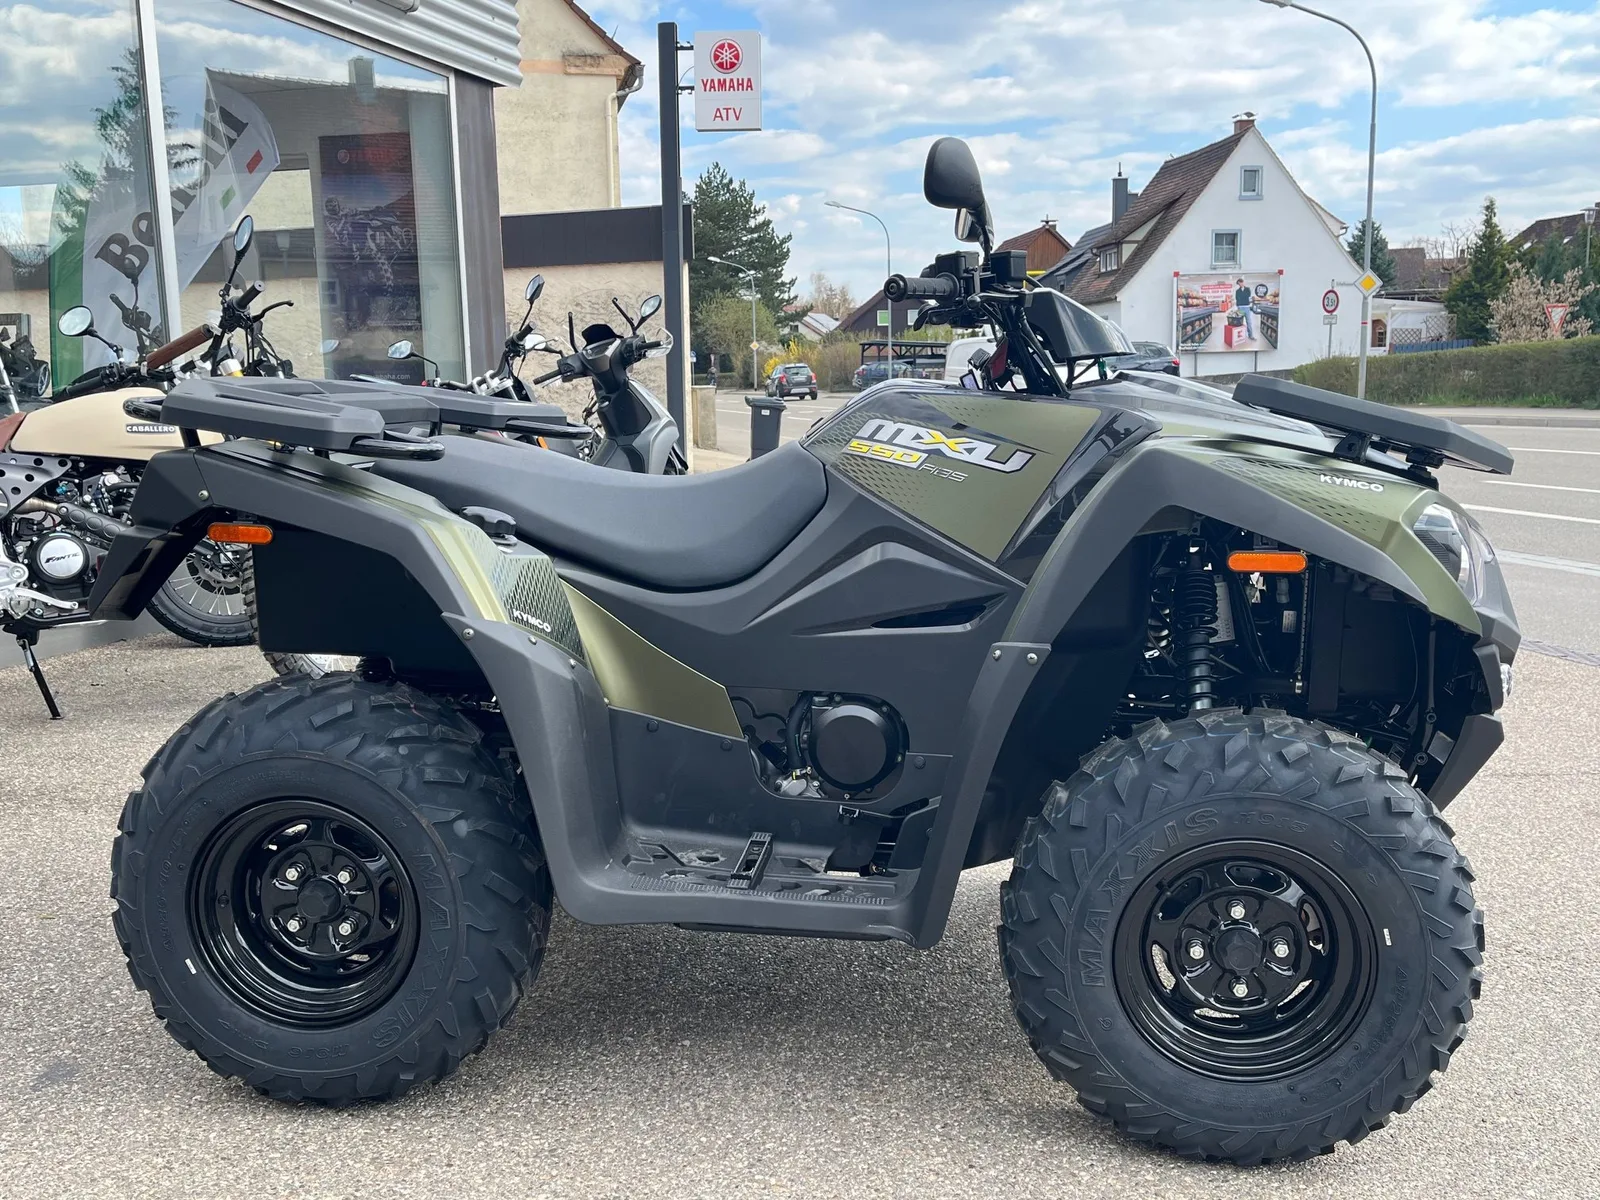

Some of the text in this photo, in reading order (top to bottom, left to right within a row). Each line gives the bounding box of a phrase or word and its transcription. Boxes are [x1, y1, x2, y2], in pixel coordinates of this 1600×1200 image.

[701, 78, 753, 92] YAMAHA
[713, 107, 742, 121] ATV
[848, 440, 922, 463] 550
[855, 418, 1036, 474] MXU
[1320, 474, 1384, 492] KYMCO
[44, 552, 80, 564] FANTIC
[513, 608, 552, 633] KYMCO
[1081, 808, 1219, 987] MAXXIS
[372, 850, 452, 1049] MAXXIS
